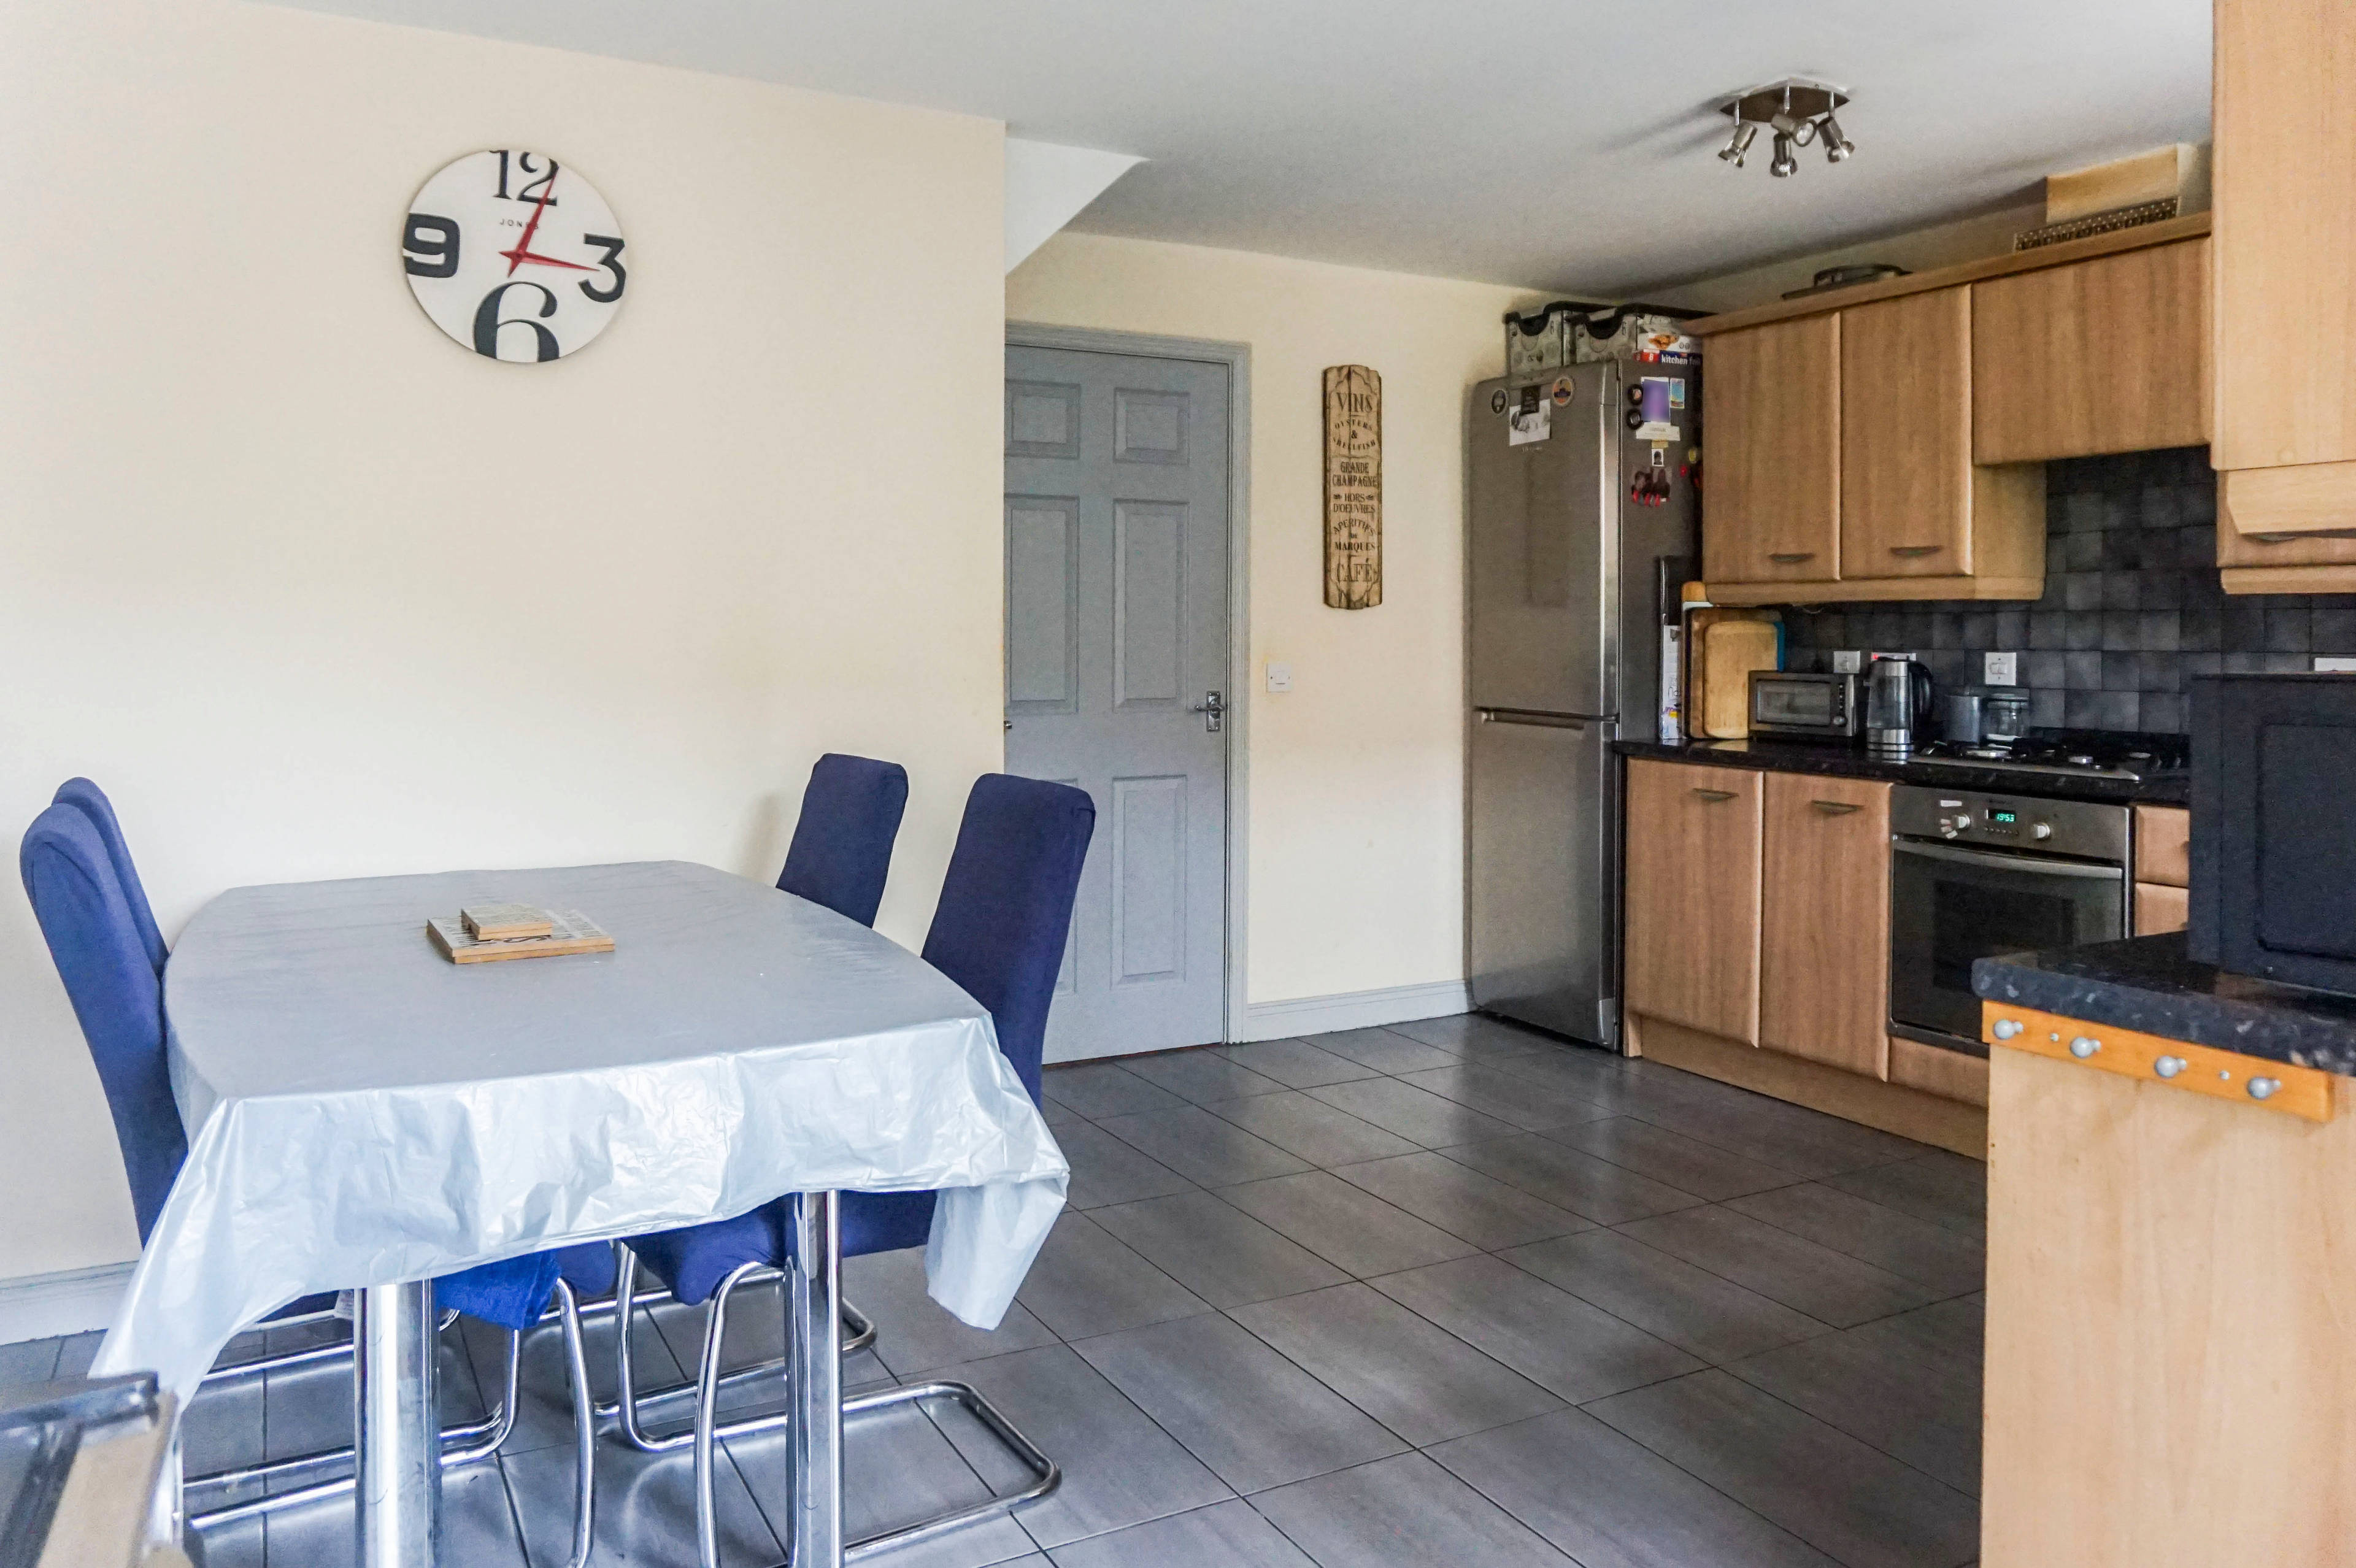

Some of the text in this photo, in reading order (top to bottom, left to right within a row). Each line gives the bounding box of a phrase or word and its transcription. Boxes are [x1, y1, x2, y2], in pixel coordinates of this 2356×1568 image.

[489, 150, 559, 206] 12
[499, 218, 539, 229] JONS
[402, 212, 460, 279] 9
[578, 233, 626, 302] 3
[472, 281, 559, 363] 6
[1661, 354, 1688, 365] kitchen
[1336, 392, 1373, 413] VINS
[1334, 418, 1373, 431] OYSTERS
[1351, 429, 1357, 439] &
[1340, 461, 1369, 474] GRANDE
[1333, 474, 1378, 488] CHAMPAGNE
[1344, 493, 1365, 502] HORS
[1334, 541, 1376, 553] MARQUES
[1336, 558, 1372, 582] CAFÉ
